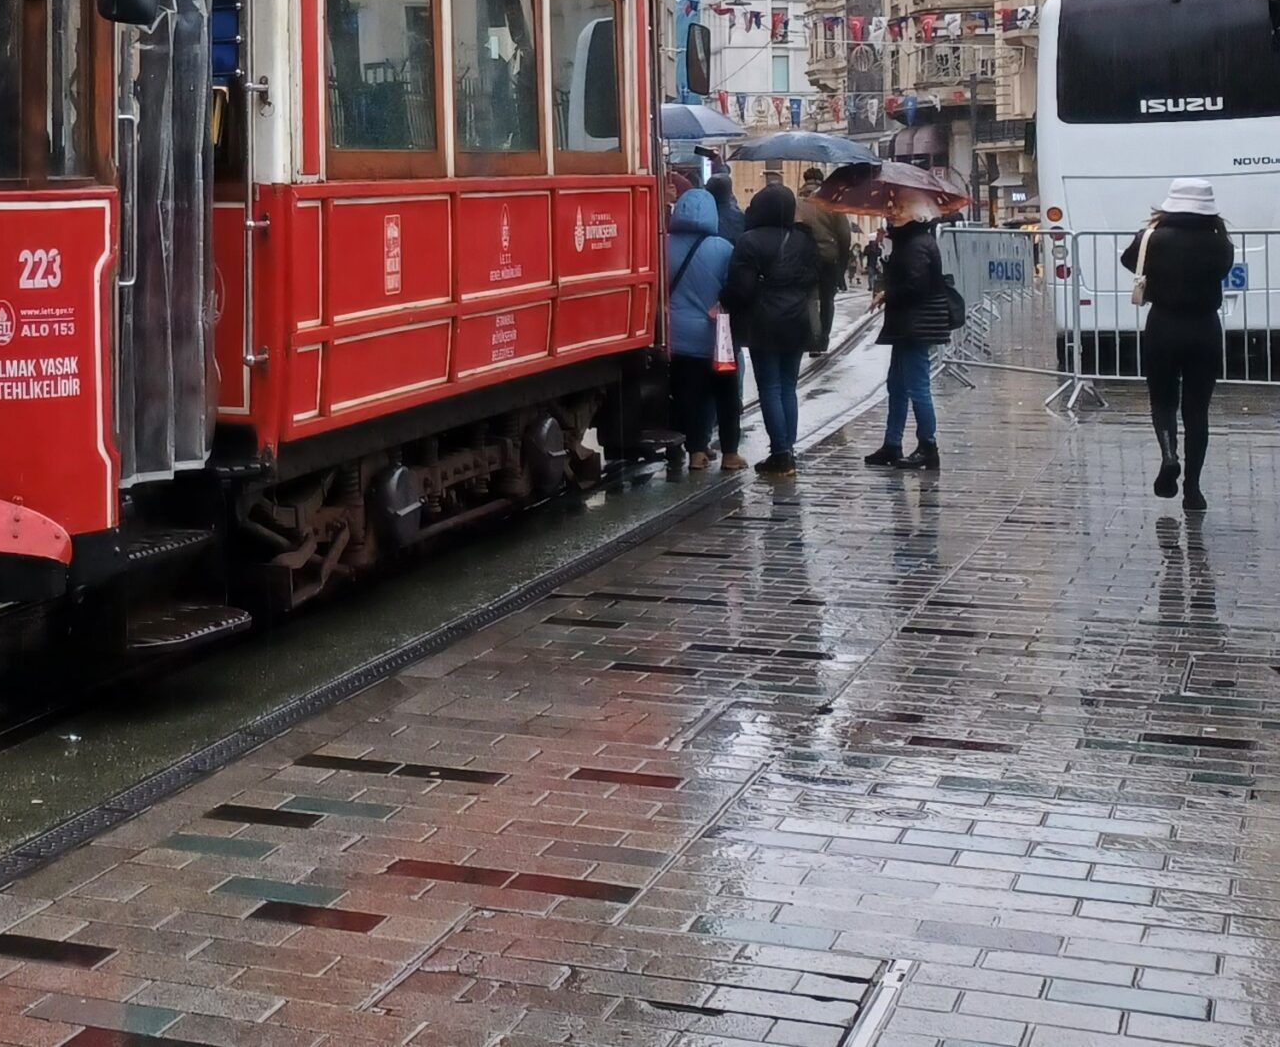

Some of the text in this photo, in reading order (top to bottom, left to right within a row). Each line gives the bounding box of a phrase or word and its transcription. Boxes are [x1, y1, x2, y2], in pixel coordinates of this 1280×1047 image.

[1140, 96, 1224, 114] ISUZU
[18, 248, 62, 289] 223
[20, 307, 75, 317] www.iett.gov.tr
[21, 322, 75, 337] ALO 153
[39, 356, 79, 376] YASAK
